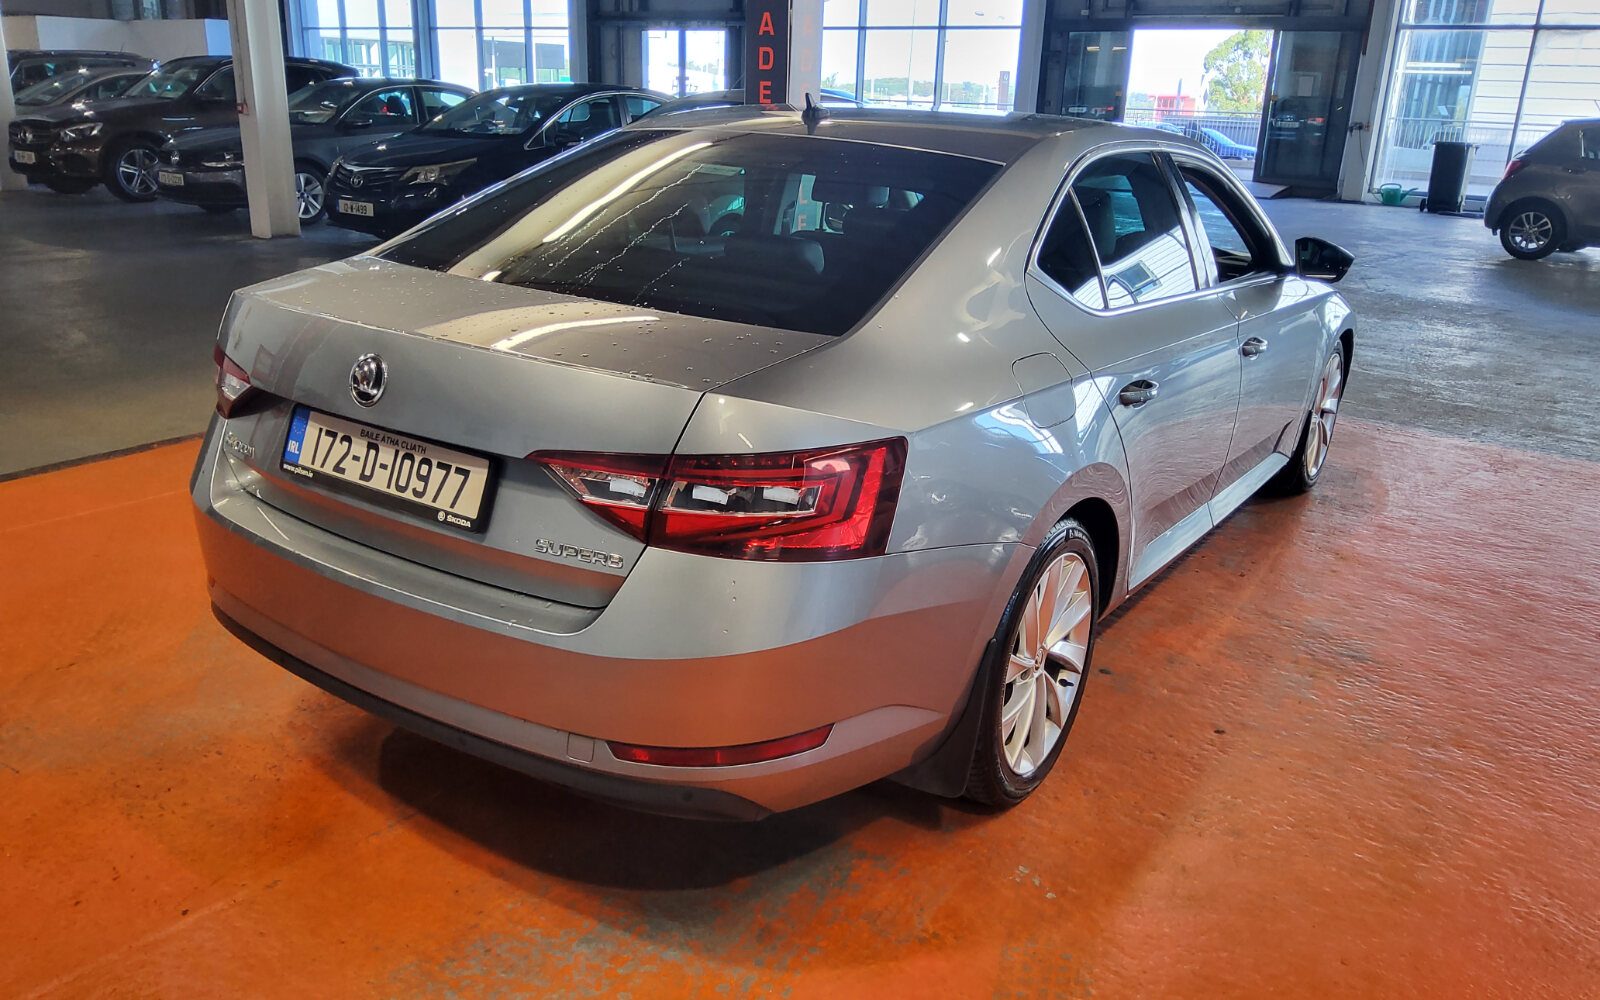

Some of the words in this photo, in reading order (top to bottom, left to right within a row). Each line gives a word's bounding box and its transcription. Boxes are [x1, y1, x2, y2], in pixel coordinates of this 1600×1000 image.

[287, 440, 300, 455] IRL
[360, 429, 380, 441] BAILE
[401, 440, 427, 455] CLIATH
[311, 427, 471, 509] 172-D-10977
[446, 514, 471, 528] ŠKODA
[534, 537, 624, 570] SUPERB
